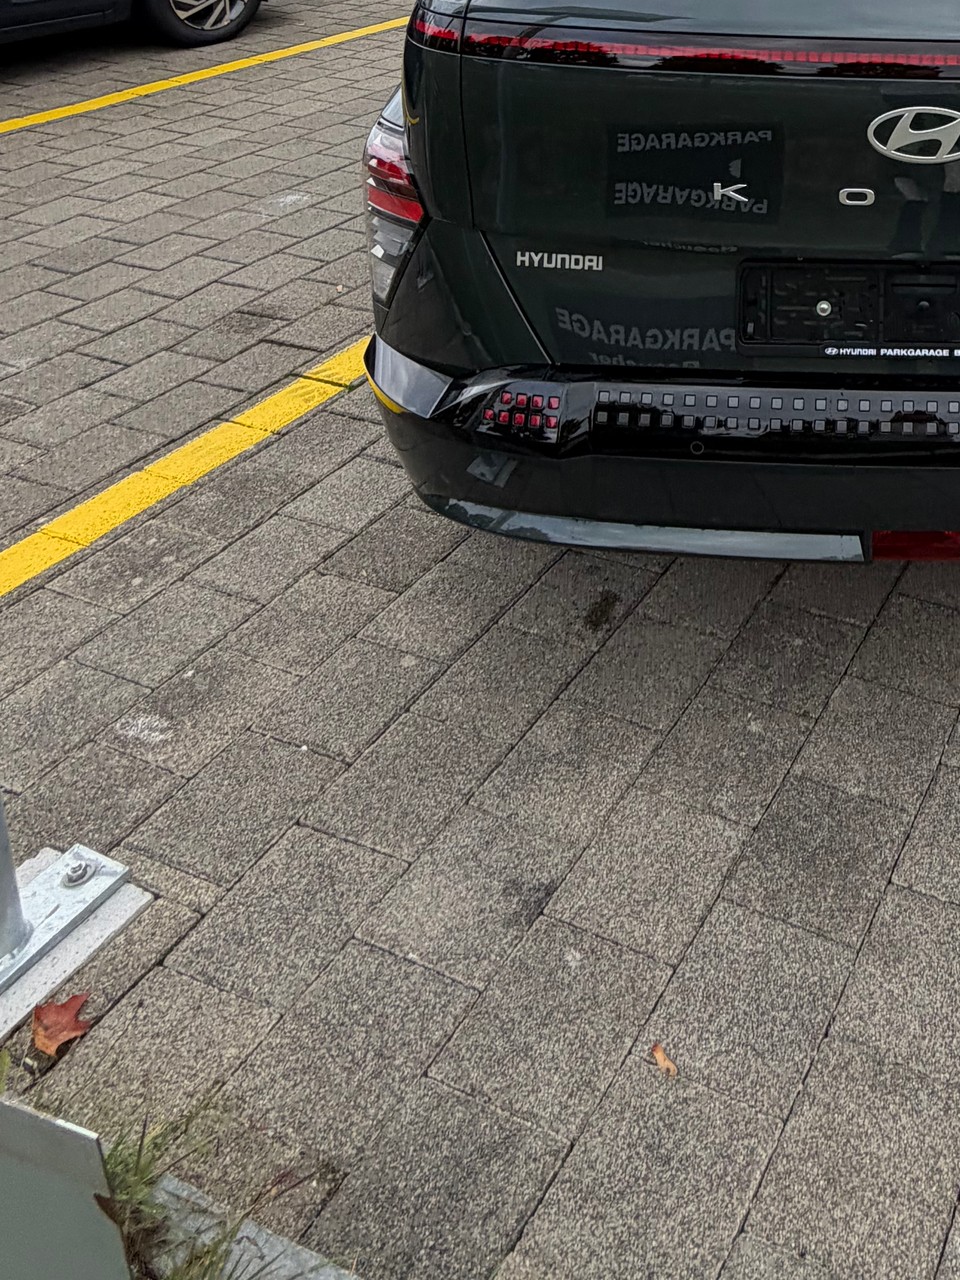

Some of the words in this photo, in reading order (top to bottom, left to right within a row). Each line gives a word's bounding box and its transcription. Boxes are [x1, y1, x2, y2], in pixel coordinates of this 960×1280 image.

[516, 250, 603, 271] HYUNDAI
[839, 348, 877, 356] HYUNDAI
[880, 348, 950, 357] PARKGARAGE
